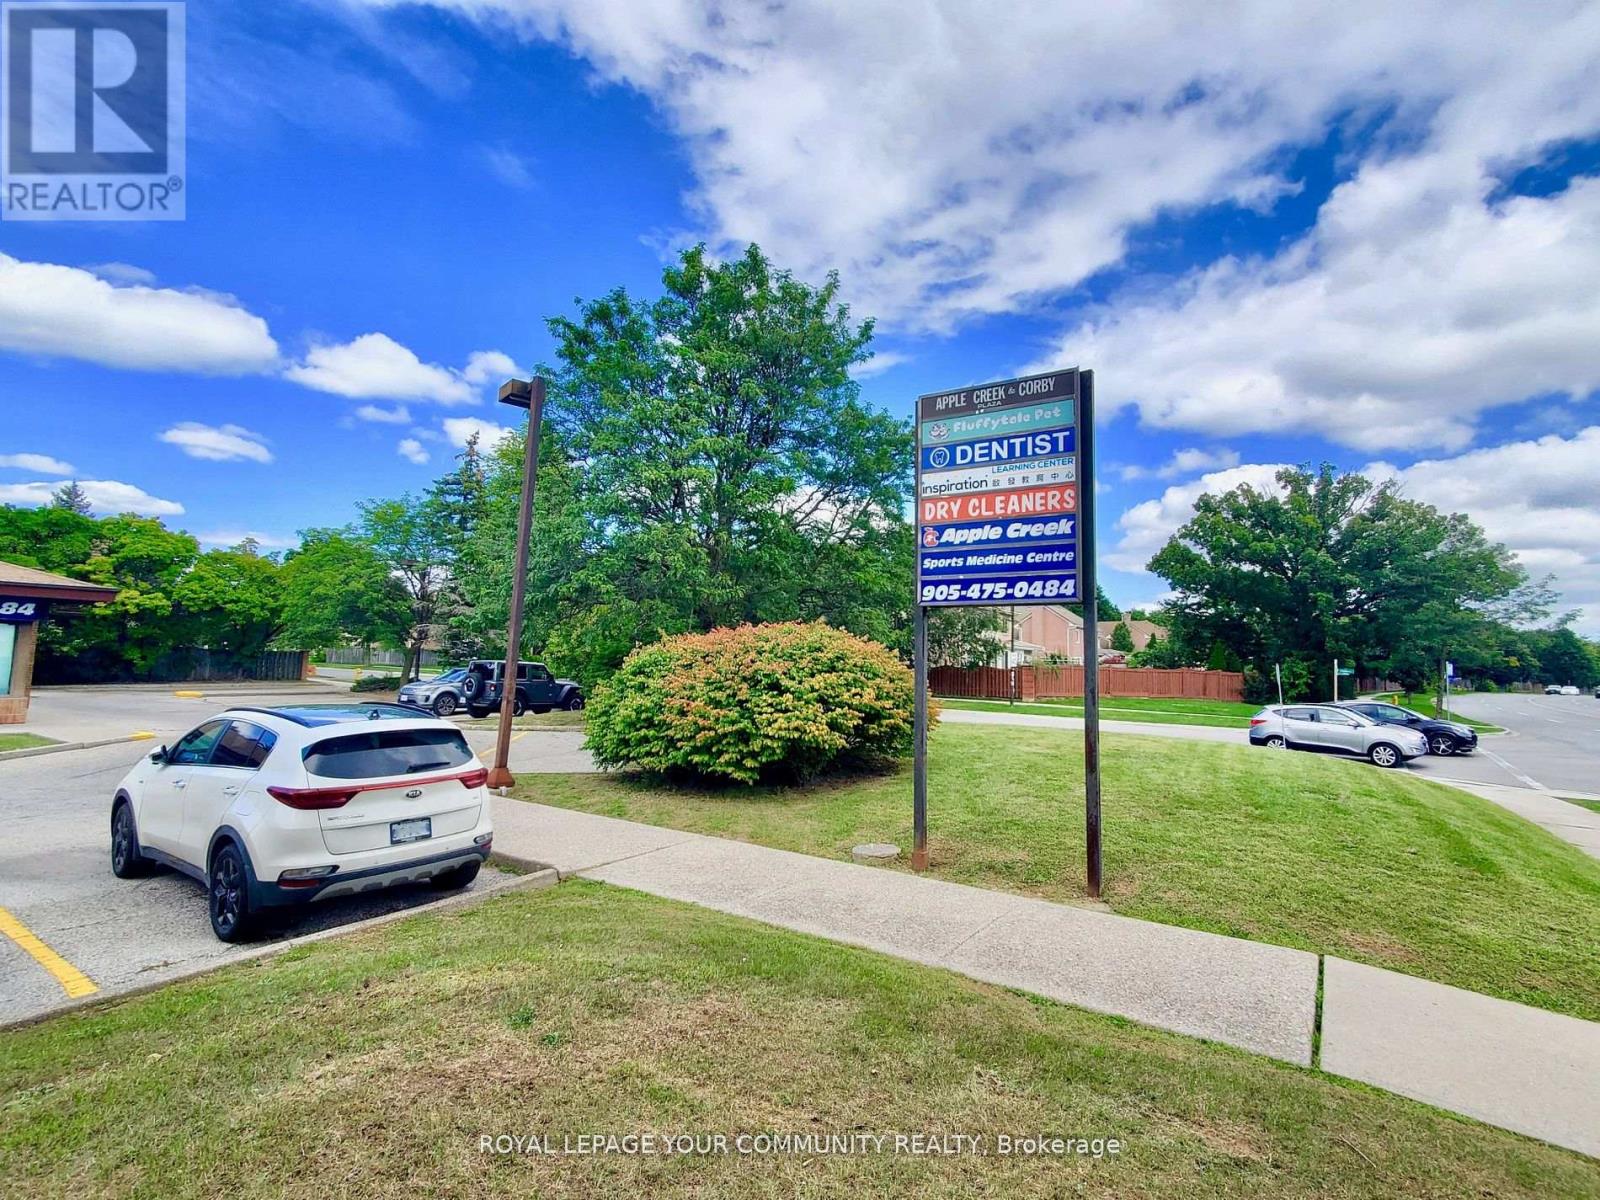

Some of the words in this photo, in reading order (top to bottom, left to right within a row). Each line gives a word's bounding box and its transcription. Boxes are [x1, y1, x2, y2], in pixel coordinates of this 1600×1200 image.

[935, 392, 967, 411] APPLE
[973, 385, 1006, 404] CREEK
[1018, 376, 1056, 397] CORBY
[977, 400, 1002, 409] PLAZA
[955, 431, 1070, 465] DENTIST
[992, 461, 1036, 474] LEARNING
[1037, 457, 1074, 469] CENTER
[922, 475, 989, 495] inspiration
[924, 497, 966, 521] DRY
[968, 488, 1076, 517] CLEANERS
[939, 525, 1003, 545] Apple
[1006, 518, 1075, 540] Creek
[922, 553, 964, 569] Sports
[966, 551, 1023, 566] Medicine
[1026, 549, 1075, 564] Centre
[922, 579, 1076, 601] 905-475-0484
